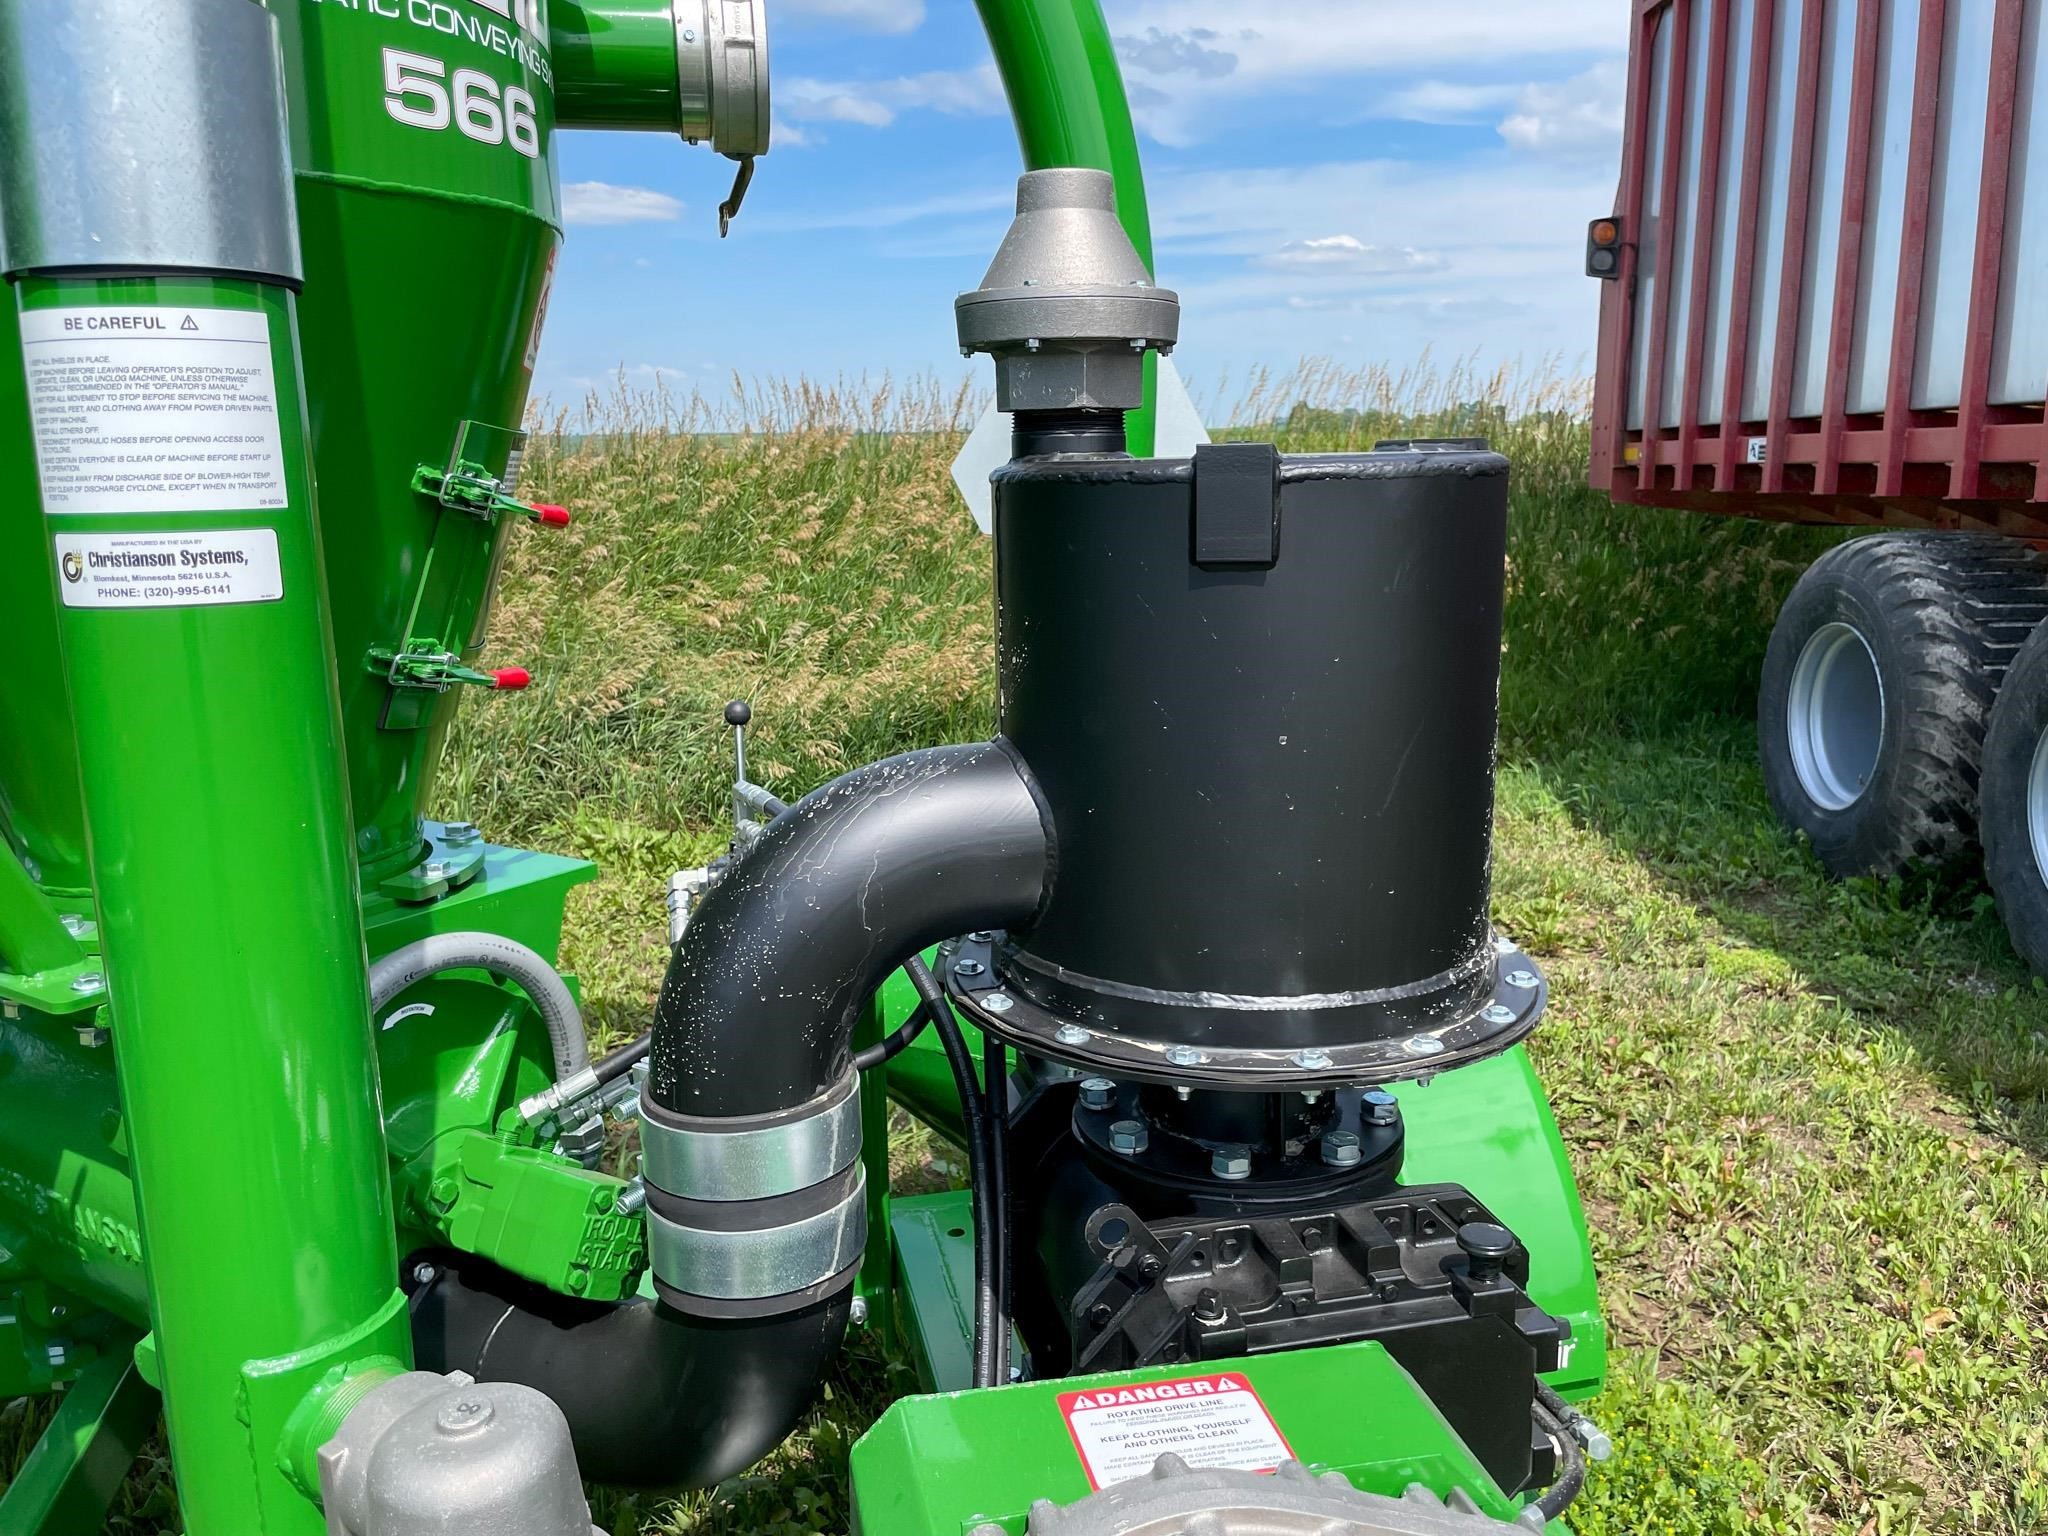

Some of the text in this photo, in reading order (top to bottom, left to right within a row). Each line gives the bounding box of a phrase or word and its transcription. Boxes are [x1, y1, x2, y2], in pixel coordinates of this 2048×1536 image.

[408, 0, 540, 76] CONVEYING
[382, 47, 539, 159] 566
[64, 317, 166, 330] BE CAREFUL
[131, 366, 183, 374] OPERATOR'S
[236, 368, 262, 376] ADJUST,
[204, 375, 248, 383] OTHERWISE
[67, 394, 105, 402] MOVEMENT
[102, 404, 141, 412] CLOTHING
[225, 404, 253, 412] DRIVEN
[126, 455, 153, 463] CLEAR
[198, 472, 252, 480] BLOWER-HIGH
[126, 484, 167, 492] CYCLONE,
[88, 549, 248, 568] Christianson Systems,
[93, 571, 232, 583] Blomkest, Minnesota 56216 U.S.A.
[97, 584, 231, 599] PHONE: (320)-995-6141
[1095, 1380, 1215, 1406] DANGER
[1107, 1406, 1163, 1419] ROTATING
[1165, 1401, 1197, 1412] DRIVE
[1199, 1399, 1224, 1408] LINE
[1100, 1434, 1129, 1443] KEEP
[1132, 1425, 1192, 1439] CLOTHING,
[1193, 1418, 1252, 1431] YOURSELF
[1124, 1429, 1238, 1449] AND OTHERS CLEAR!
